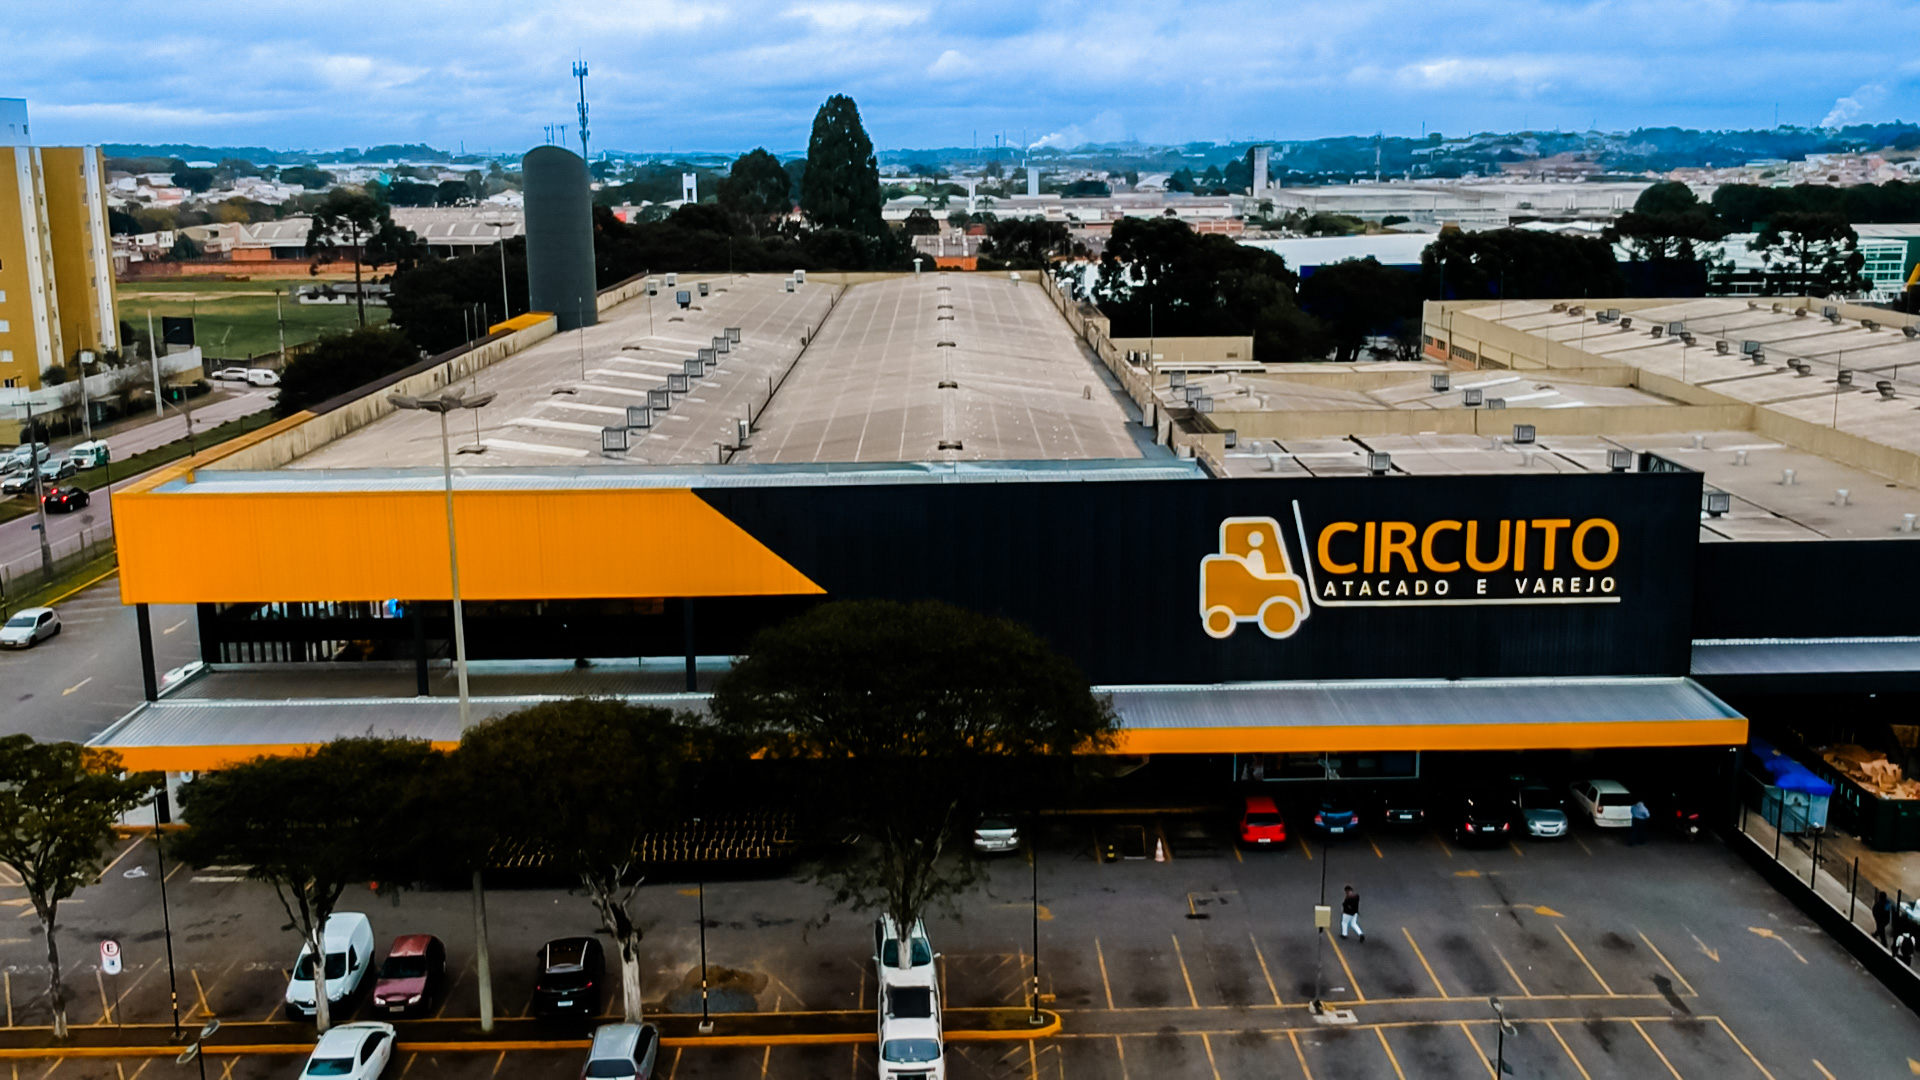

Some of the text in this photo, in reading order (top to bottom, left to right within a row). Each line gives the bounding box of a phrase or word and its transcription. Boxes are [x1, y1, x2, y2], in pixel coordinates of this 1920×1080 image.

[1317, 518, 1620, 575] CIRCUITO
[1323, 576, 1615, 597] ATACADO E VAREJO
